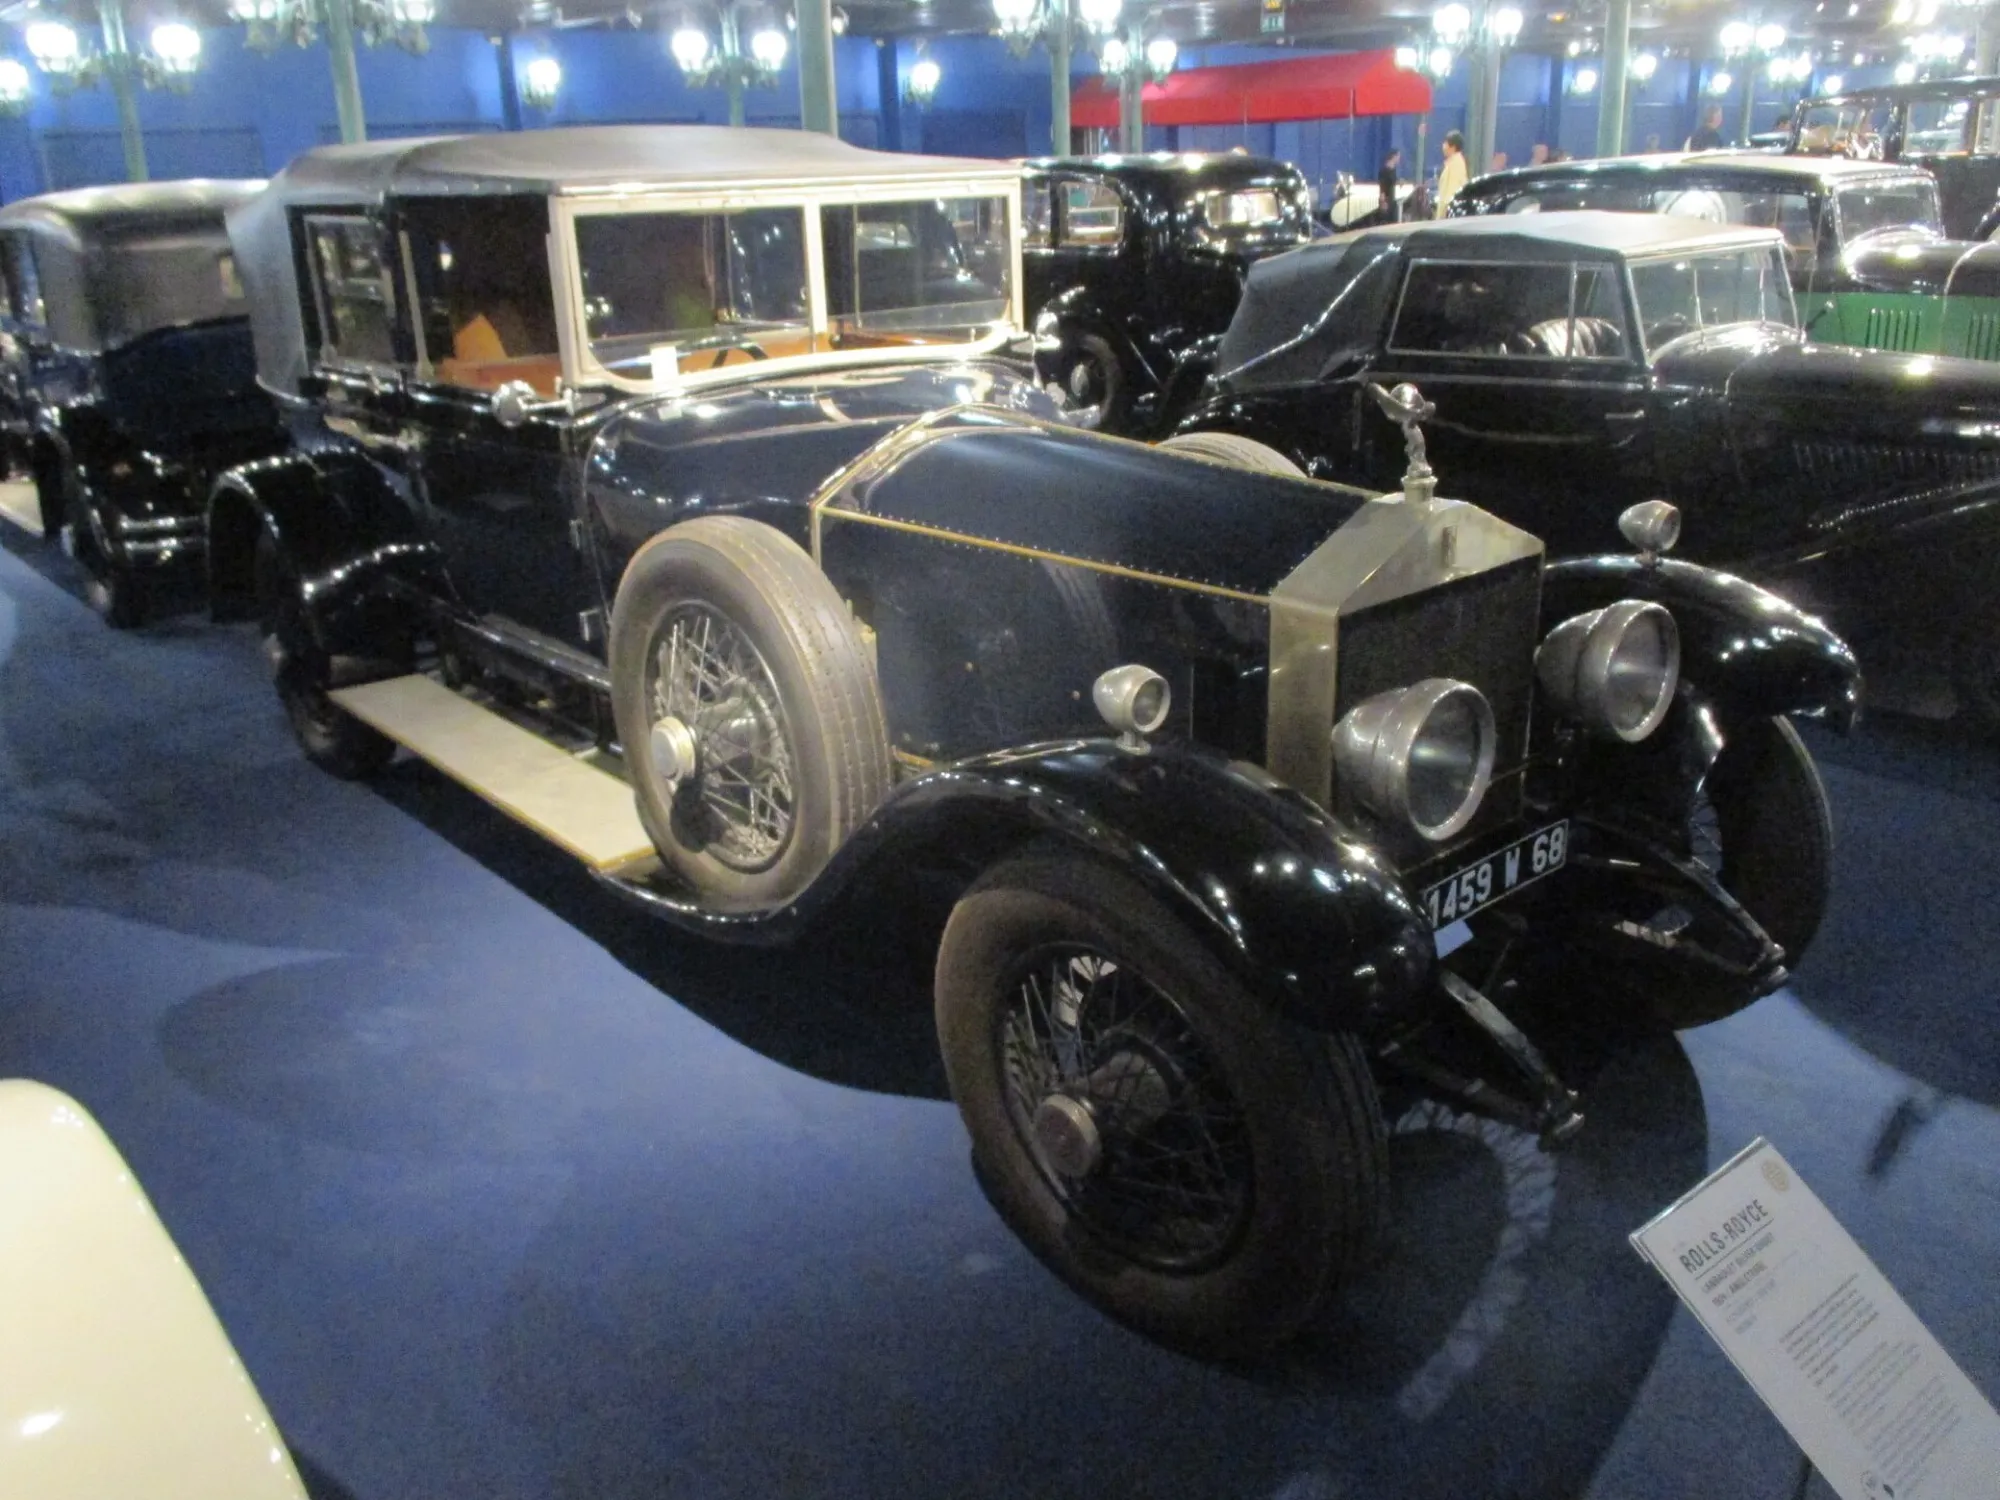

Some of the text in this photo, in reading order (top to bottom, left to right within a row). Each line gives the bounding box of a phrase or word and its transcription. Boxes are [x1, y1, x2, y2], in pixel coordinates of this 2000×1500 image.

[1429, 826, 1564, 928] 1459 W 68
[1680, 1199, 1769, 1274] ROLLS-ROYCE
